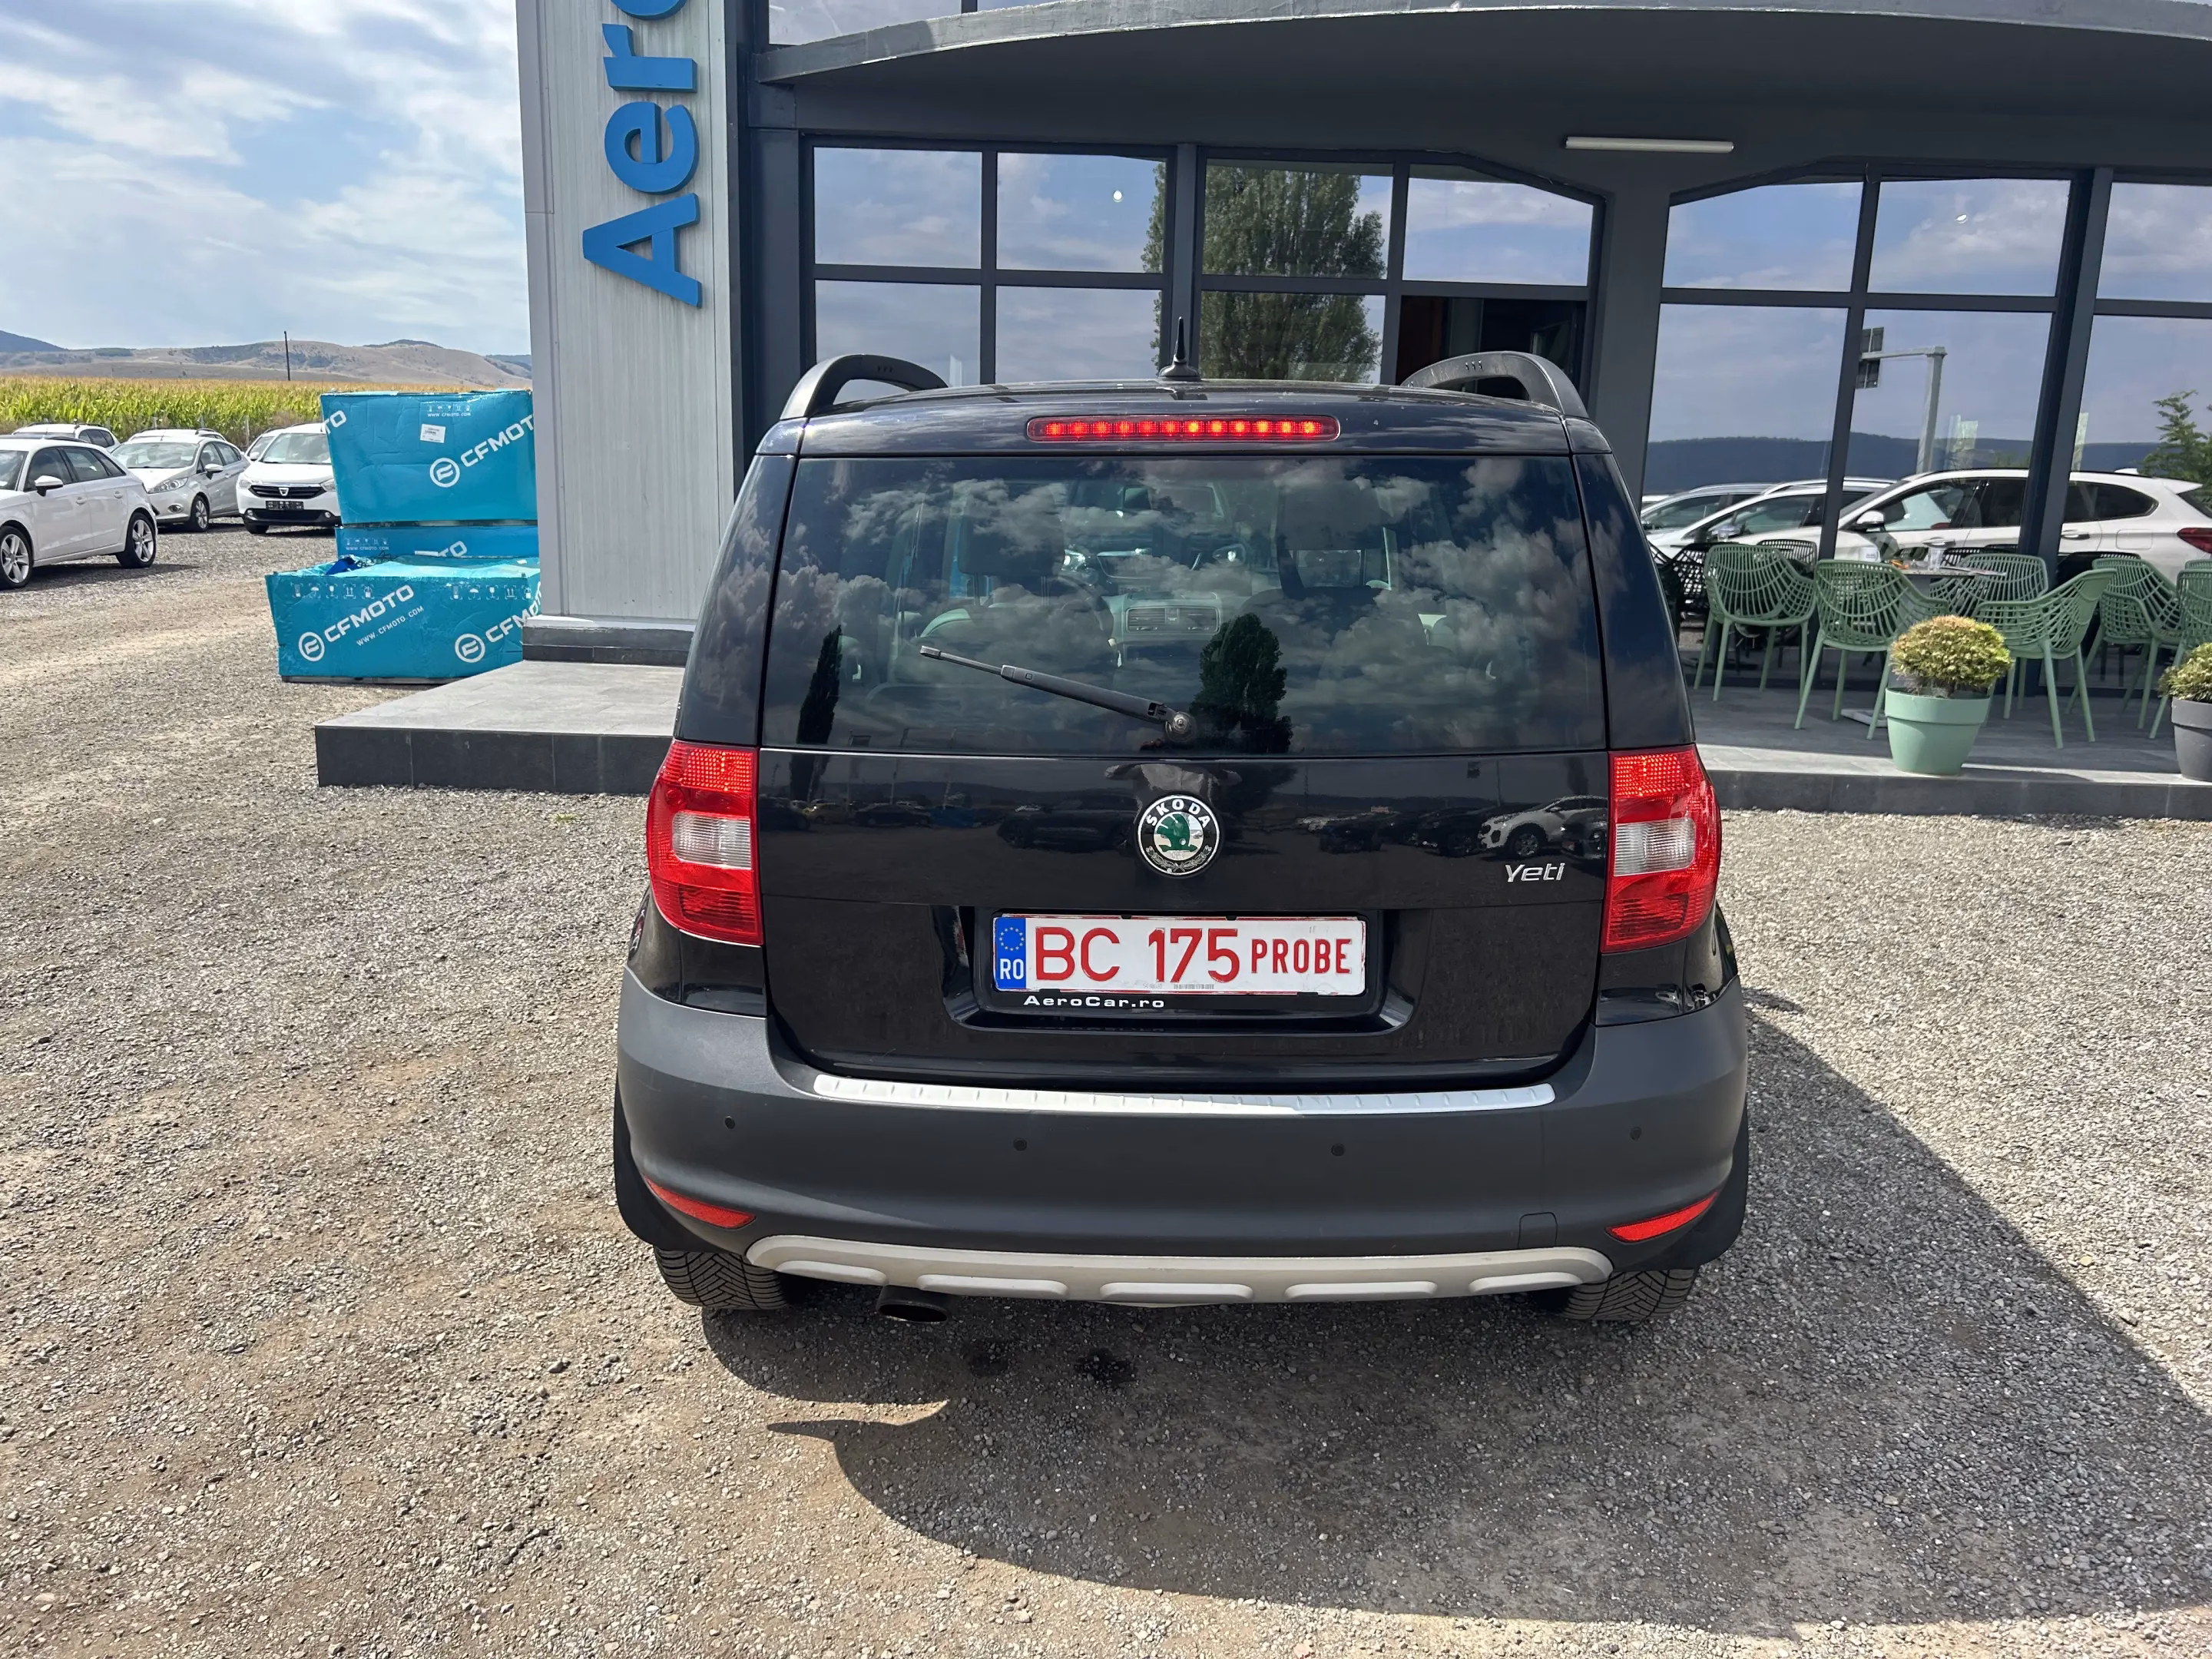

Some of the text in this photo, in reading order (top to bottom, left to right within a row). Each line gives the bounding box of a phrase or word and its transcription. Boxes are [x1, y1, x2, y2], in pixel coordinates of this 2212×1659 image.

[583, 0, 702, 308] Aer
[324, 584, 414, 643] CFMOTO
[1505, 863, 1565, 882] Yeti
[1000, 959, 1024, 980] RO
[1035, 926, 1352, 983] BC 175 PROBE
[1023, 995, 1164, 1008] AeroCar.ro
